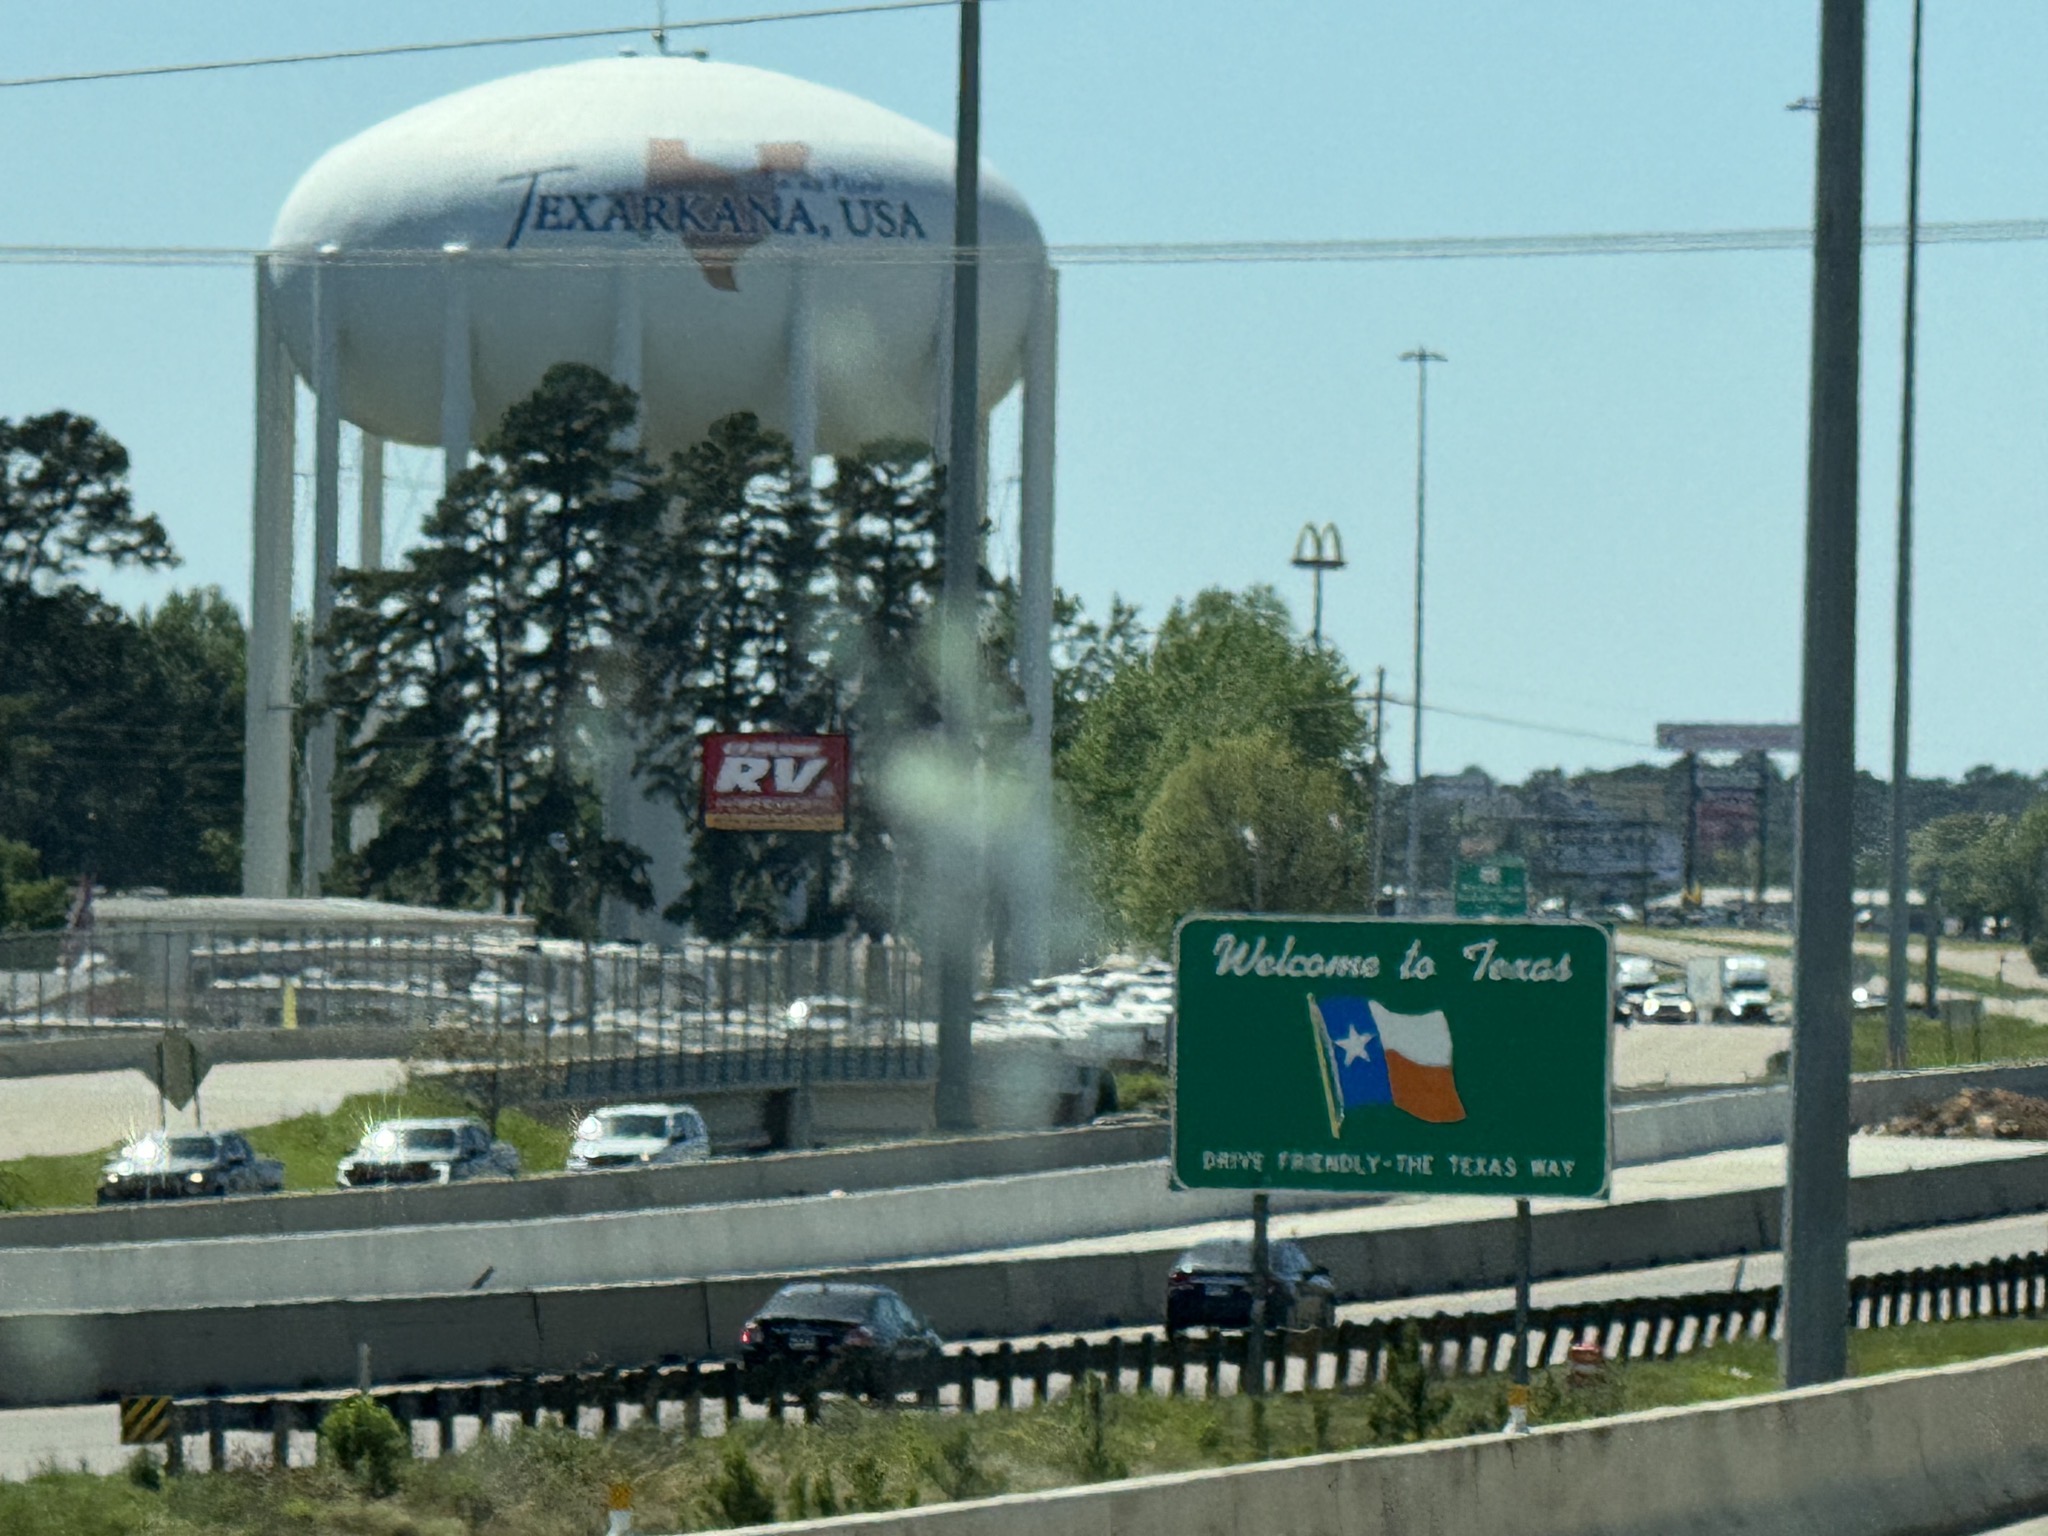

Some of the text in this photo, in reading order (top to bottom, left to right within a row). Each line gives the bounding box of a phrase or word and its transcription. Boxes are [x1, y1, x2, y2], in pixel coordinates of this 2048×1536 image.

[499, 165, 927, 249] TEXARKANA, USA
[714, 755, 829, 794] RV
[1212, 932, 1574, 982] Welcome to Texas
[1448, 1153, 1518, 1179] TEXAS
[1529, 1158, 1576, 1179] WAY
